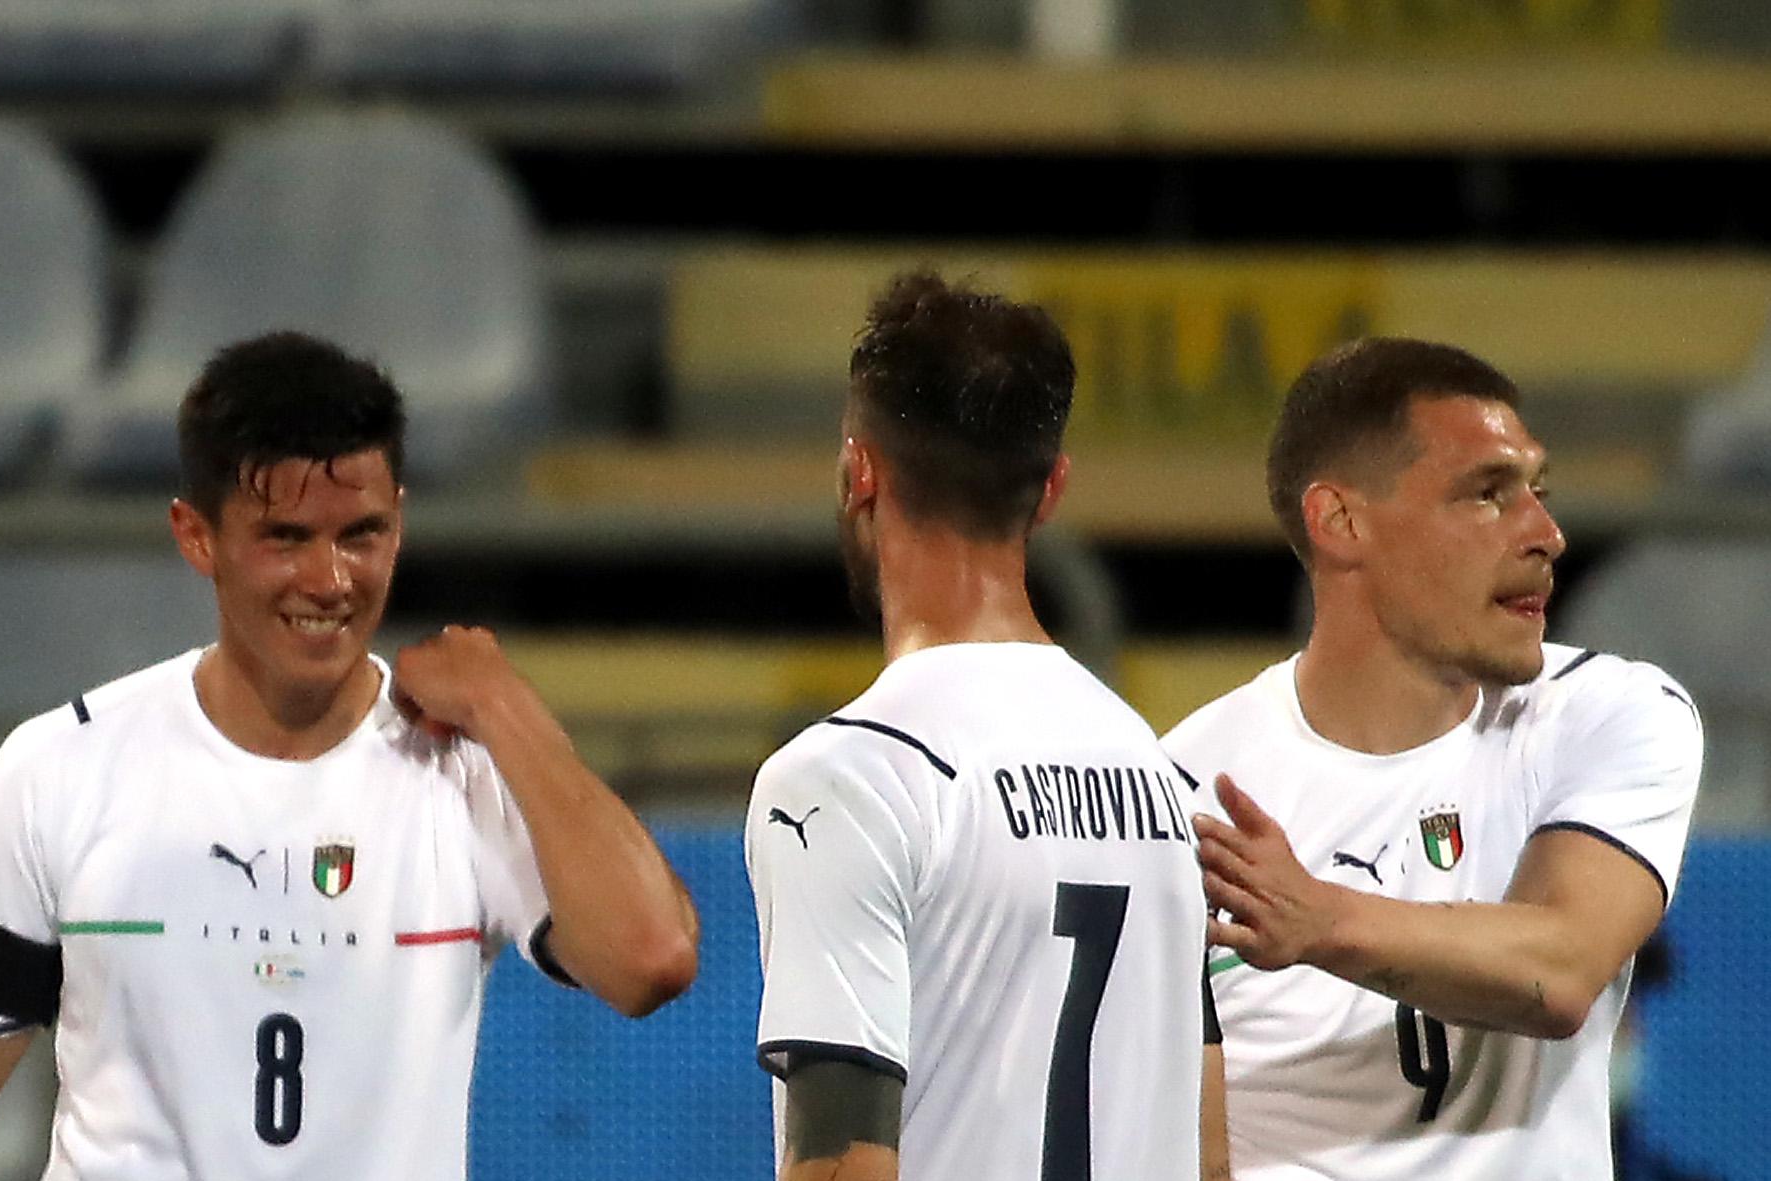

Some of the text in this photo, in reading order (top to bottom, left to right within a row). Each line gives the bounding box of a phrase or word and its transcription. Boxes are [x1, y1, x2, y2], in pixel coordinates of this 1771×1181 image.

[202, 922, 358, 947] ITALIA
[253, 1012, 306, 1148] 8
[1395, 1000, 1450, 1123] 9
